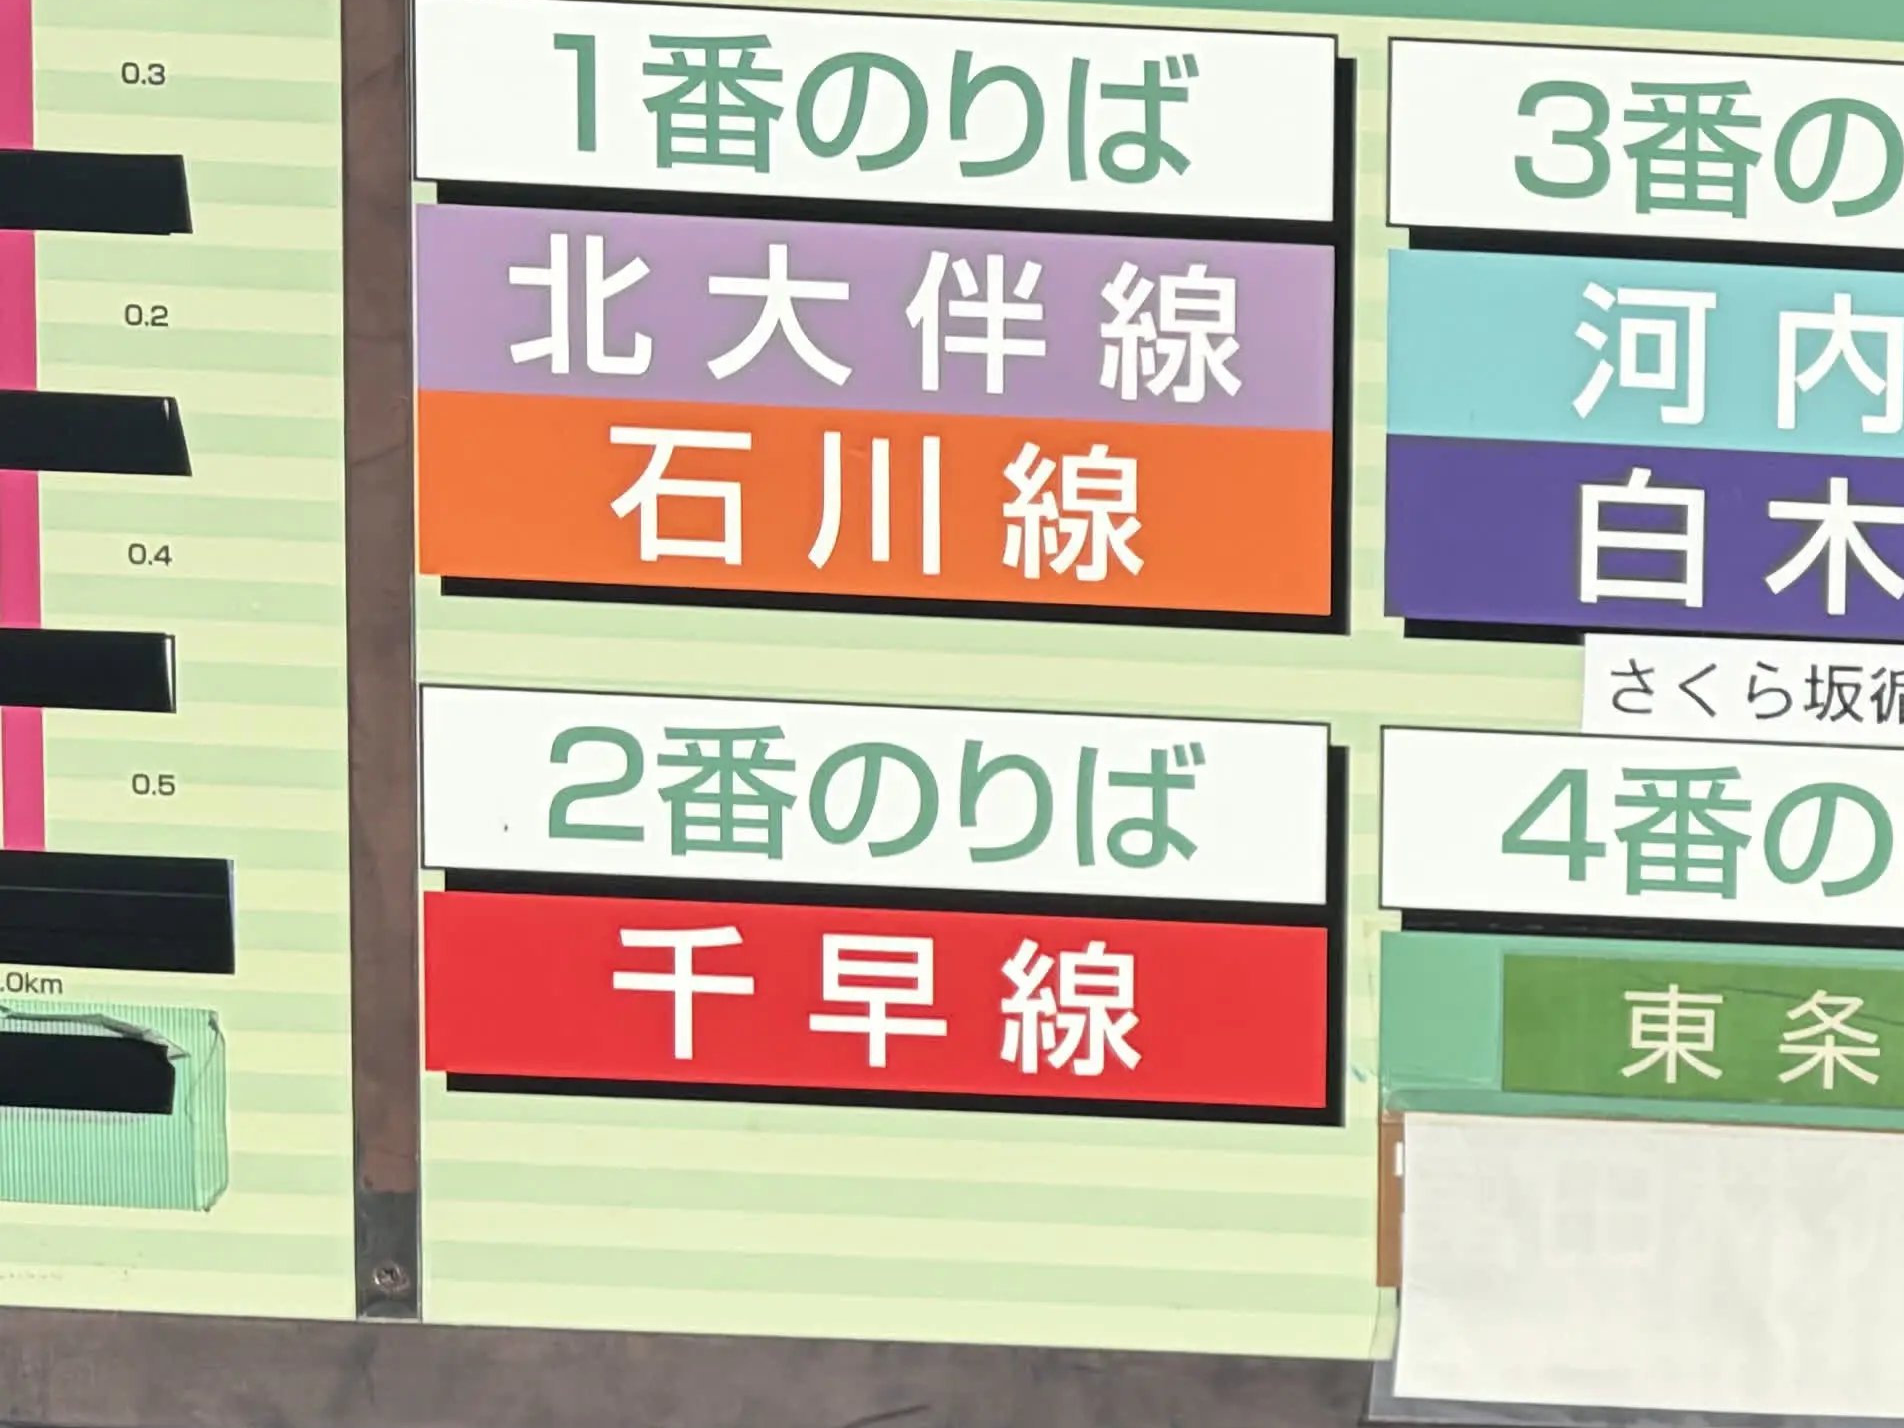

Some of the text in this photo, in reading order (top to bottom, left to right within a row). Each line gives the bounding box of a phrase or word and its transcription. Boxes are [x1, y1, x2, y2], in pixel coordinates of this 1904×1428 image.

[121, 61, 166, 86] 0.3
[548, 26, 1202, 186] 1番のりば
[124, 303, 169, 327] 0.2
[509, 233, 1242, 403] 北大伴線
[127, 542, 173, 567] 0.4
[609, 426, 1144, 582] 石川線
[131, 773, 176, 797] 0.5
[541, 720, 1209, 878] 2番のりば
[612, 926, 1141, 1076] 千早線
